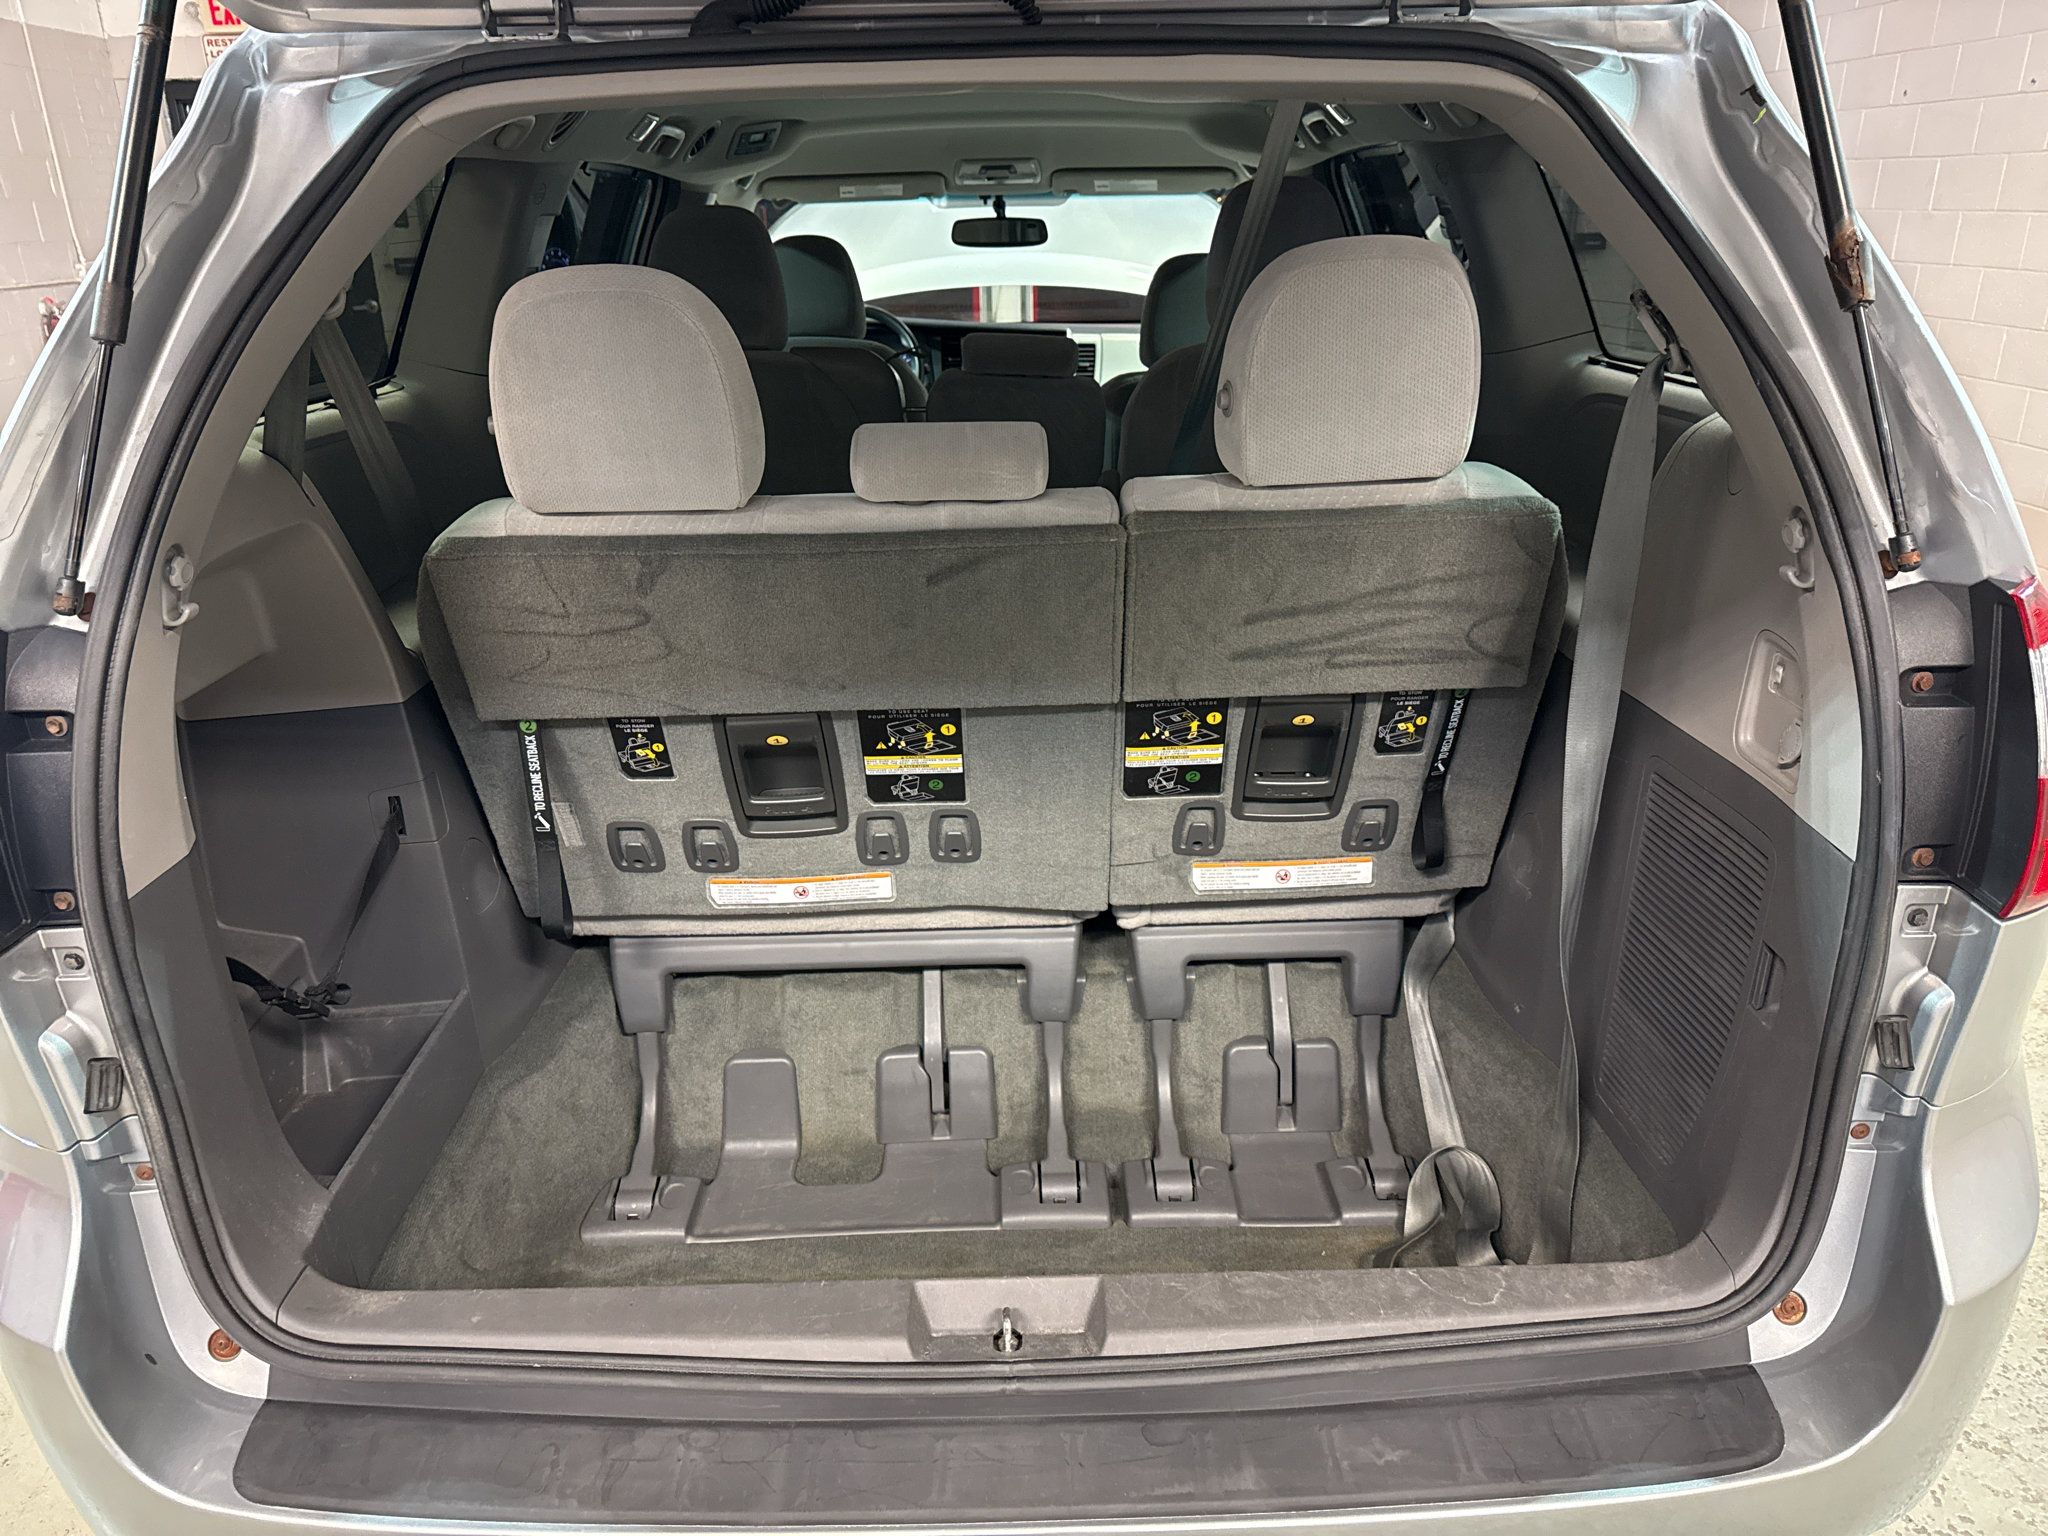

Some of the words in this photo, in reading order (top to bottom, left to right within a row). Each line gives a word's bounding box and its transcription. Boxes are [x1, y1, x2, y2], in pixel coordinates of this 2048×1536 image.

[1448, 698, 1465, 729] SEATBACK
[524, 735, 541, 771] SEATBACK
[1440, 729, 1456, 753] RECLINE
[1438, 752, 1449, 760] TO
[529, 772, 545, 801] RECLINE
[534, 802, 546, 811] TO
